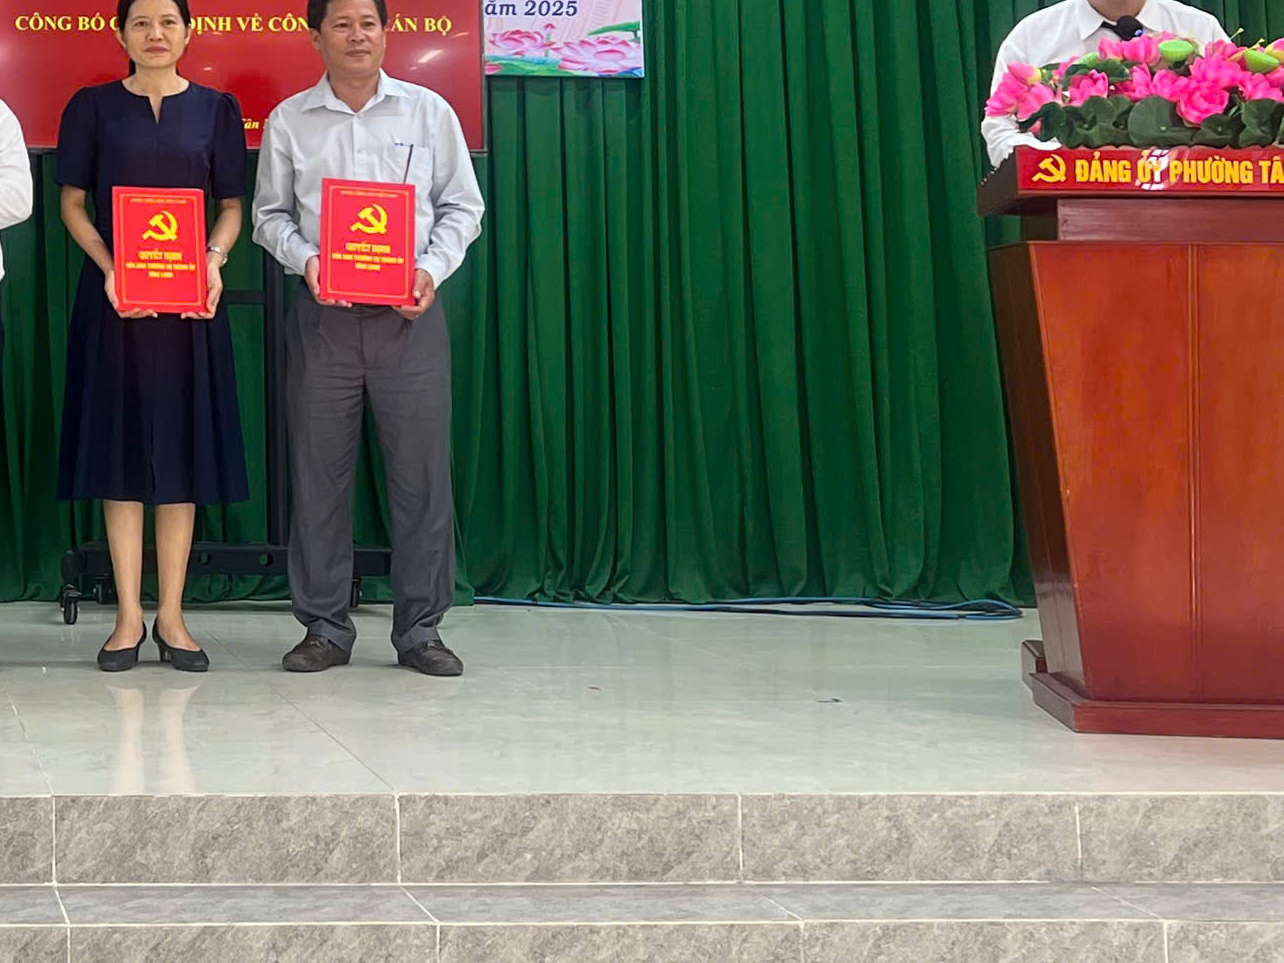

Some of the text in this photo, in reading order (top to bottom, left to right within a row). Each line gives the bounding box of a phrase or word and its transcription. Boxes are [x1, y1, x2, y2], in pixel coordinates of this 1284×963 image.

[485, 0, 578, 17] ăm 2025
[15, 12, 72, 31] CÔNG
[78, 12, 106, 31] BỐ
[236, 13, 264, 32] VỀ
[268, 13, 309, 32] CÔN
[384, 13, 452, 36] ÁN BỘ
[1075, 151, 1131, 183] ĐẢNG
[1169, 155, 1253, 184] PHƯỜNG
[1258, 156, 1284, 184] TÂ
